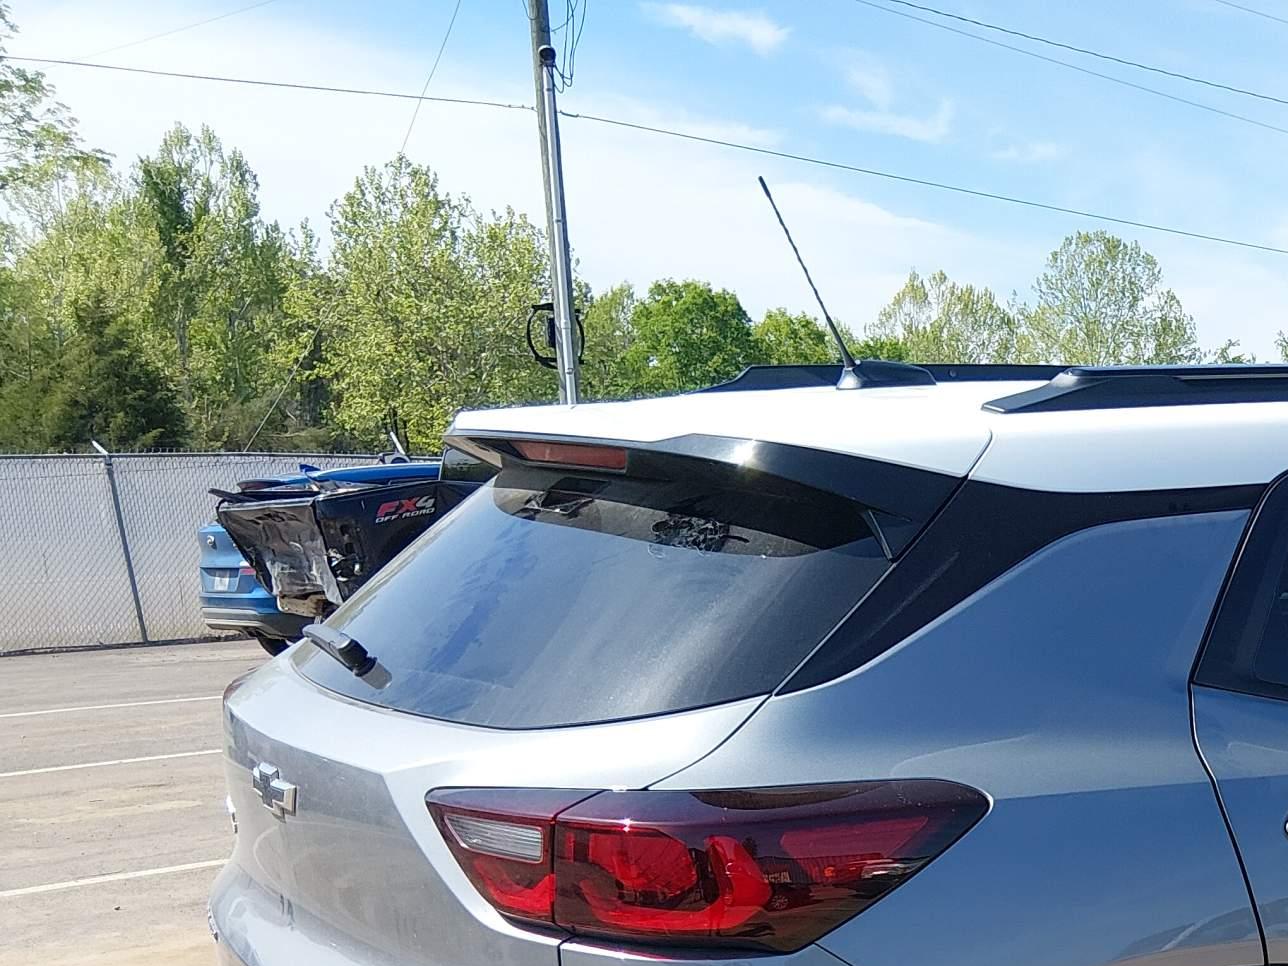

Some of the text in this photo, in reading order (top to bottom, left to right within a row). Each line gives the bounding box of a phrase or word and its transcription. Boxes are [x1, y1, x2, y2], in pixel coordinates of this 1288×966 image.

[375, 507, 436, 524] OFF ROAD
[376, 494, 436, 518] FX4
